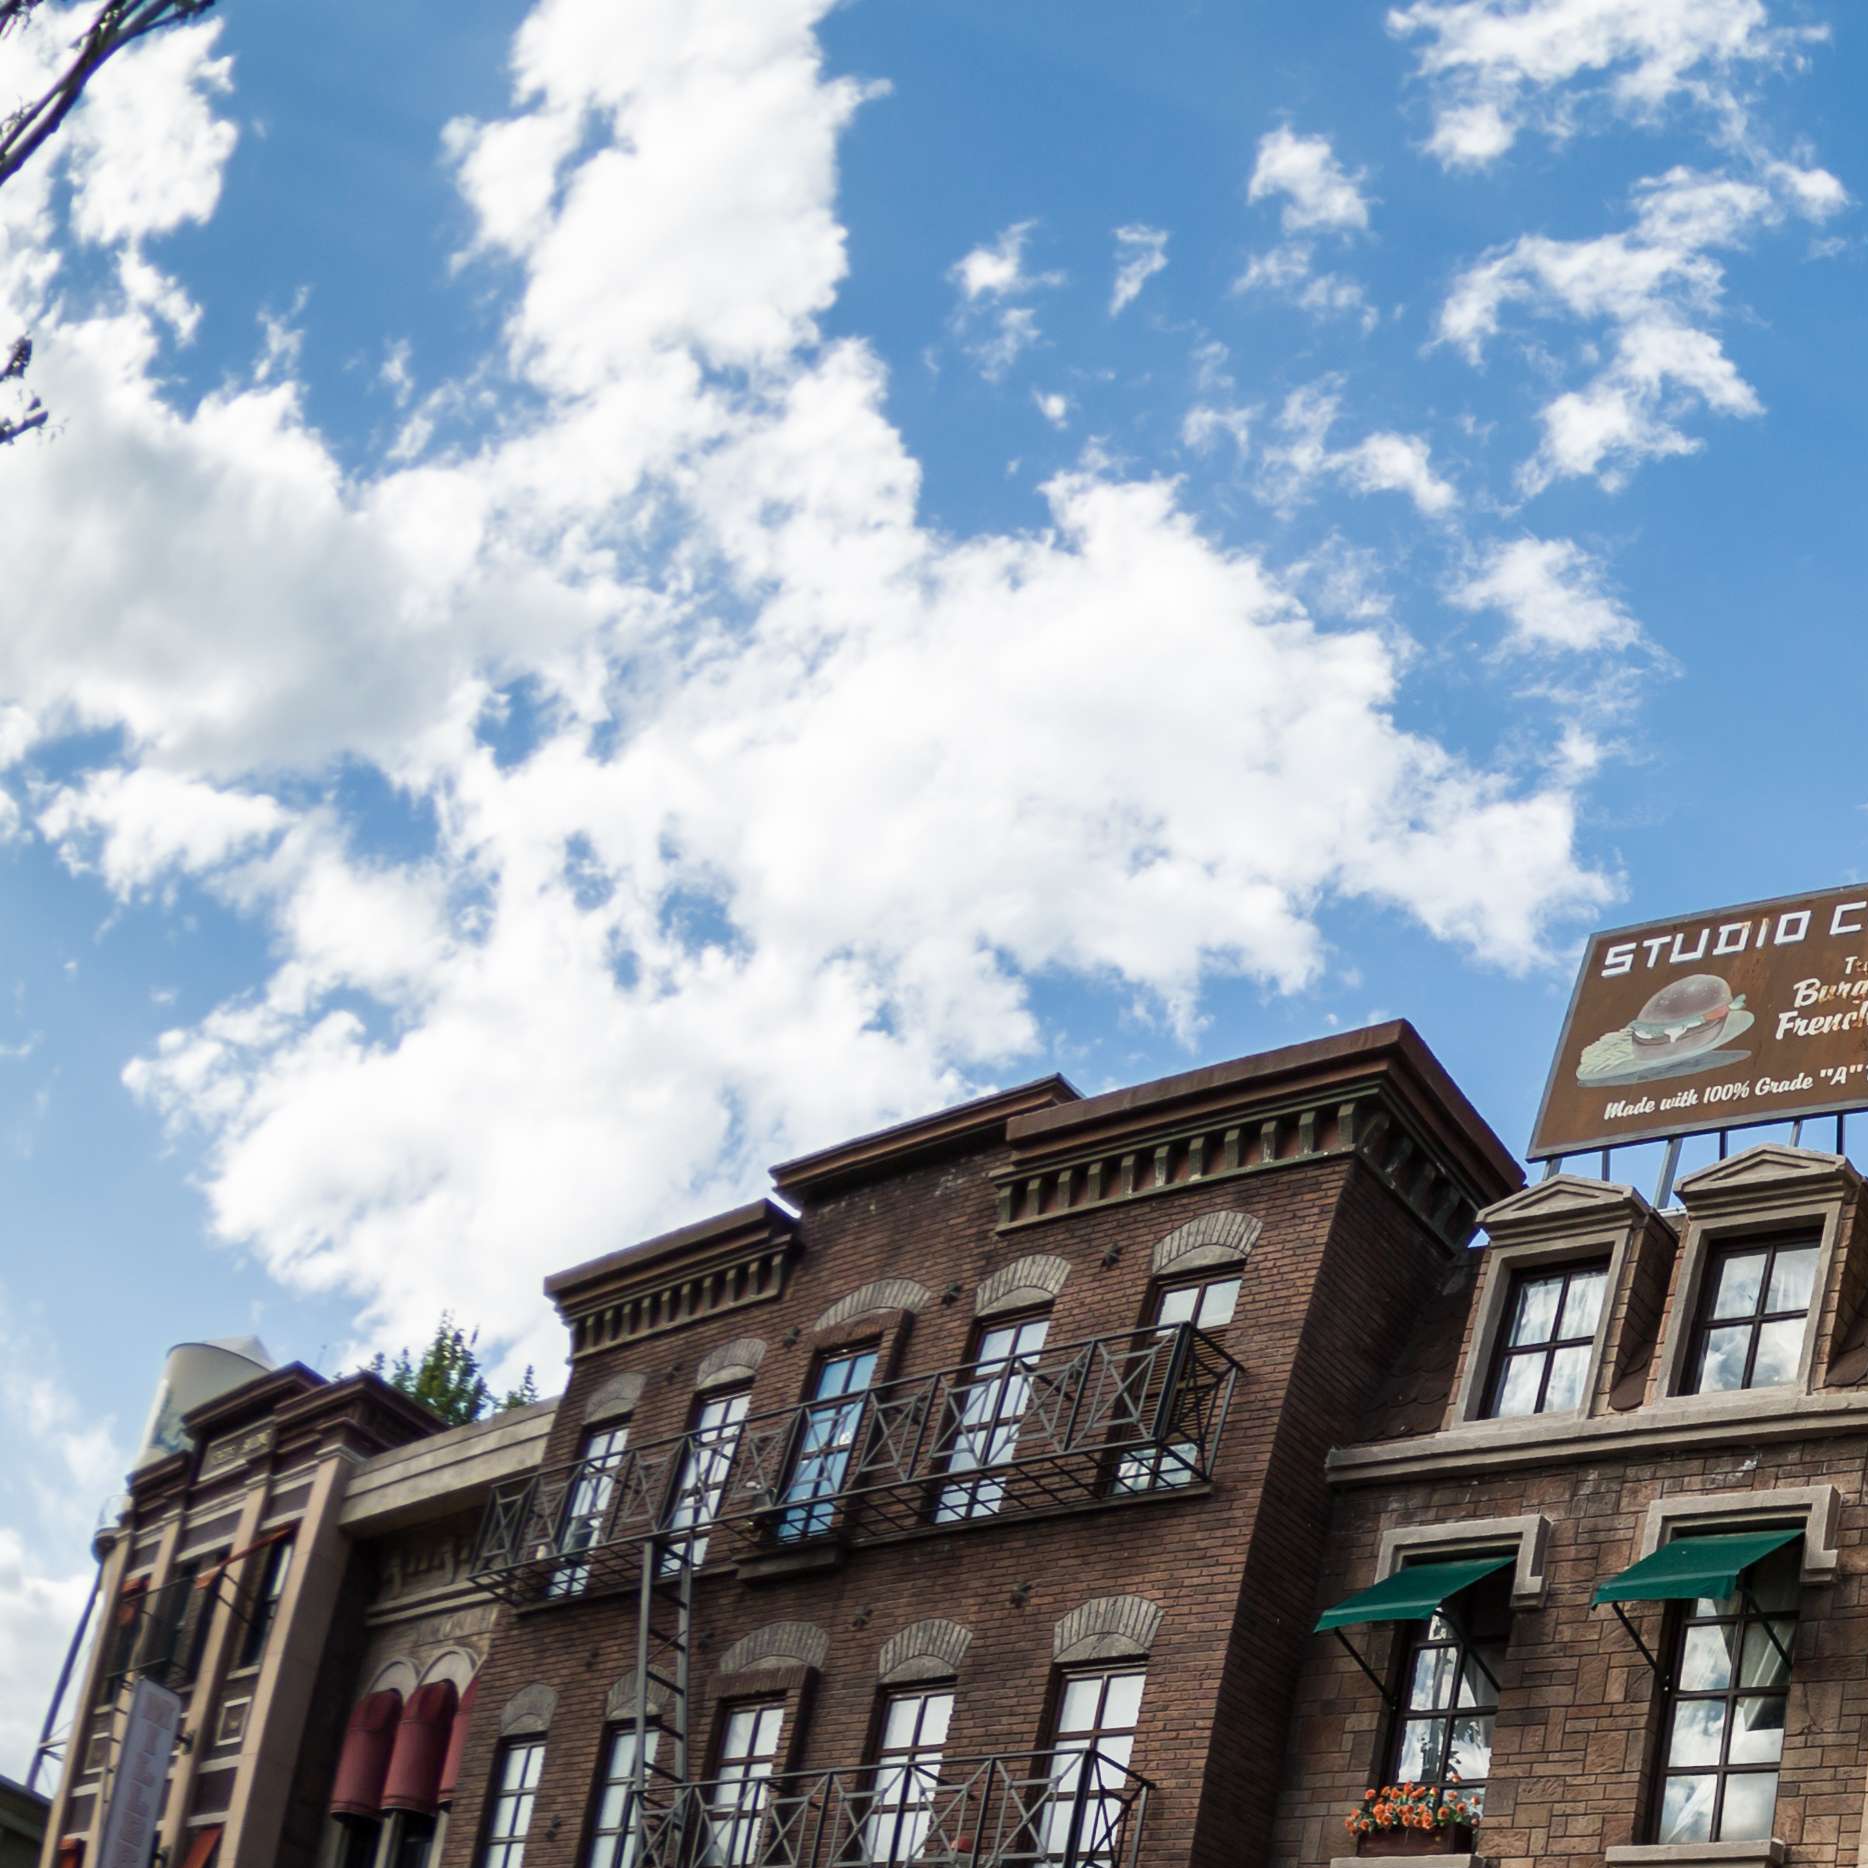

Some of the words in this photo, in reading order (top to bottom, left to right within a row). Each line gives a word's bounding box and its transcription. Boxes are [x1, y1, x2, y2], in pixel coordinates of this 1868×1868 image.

[1600, 910, 1812, 978] STUDIO
[1603, 1095, 1656, 1120] Made
[1660, 1088, 1699, 1111] with
[1703, 1079, 1751, 1105] 100%
[1755, 1071, 1814, 1096] Grade
